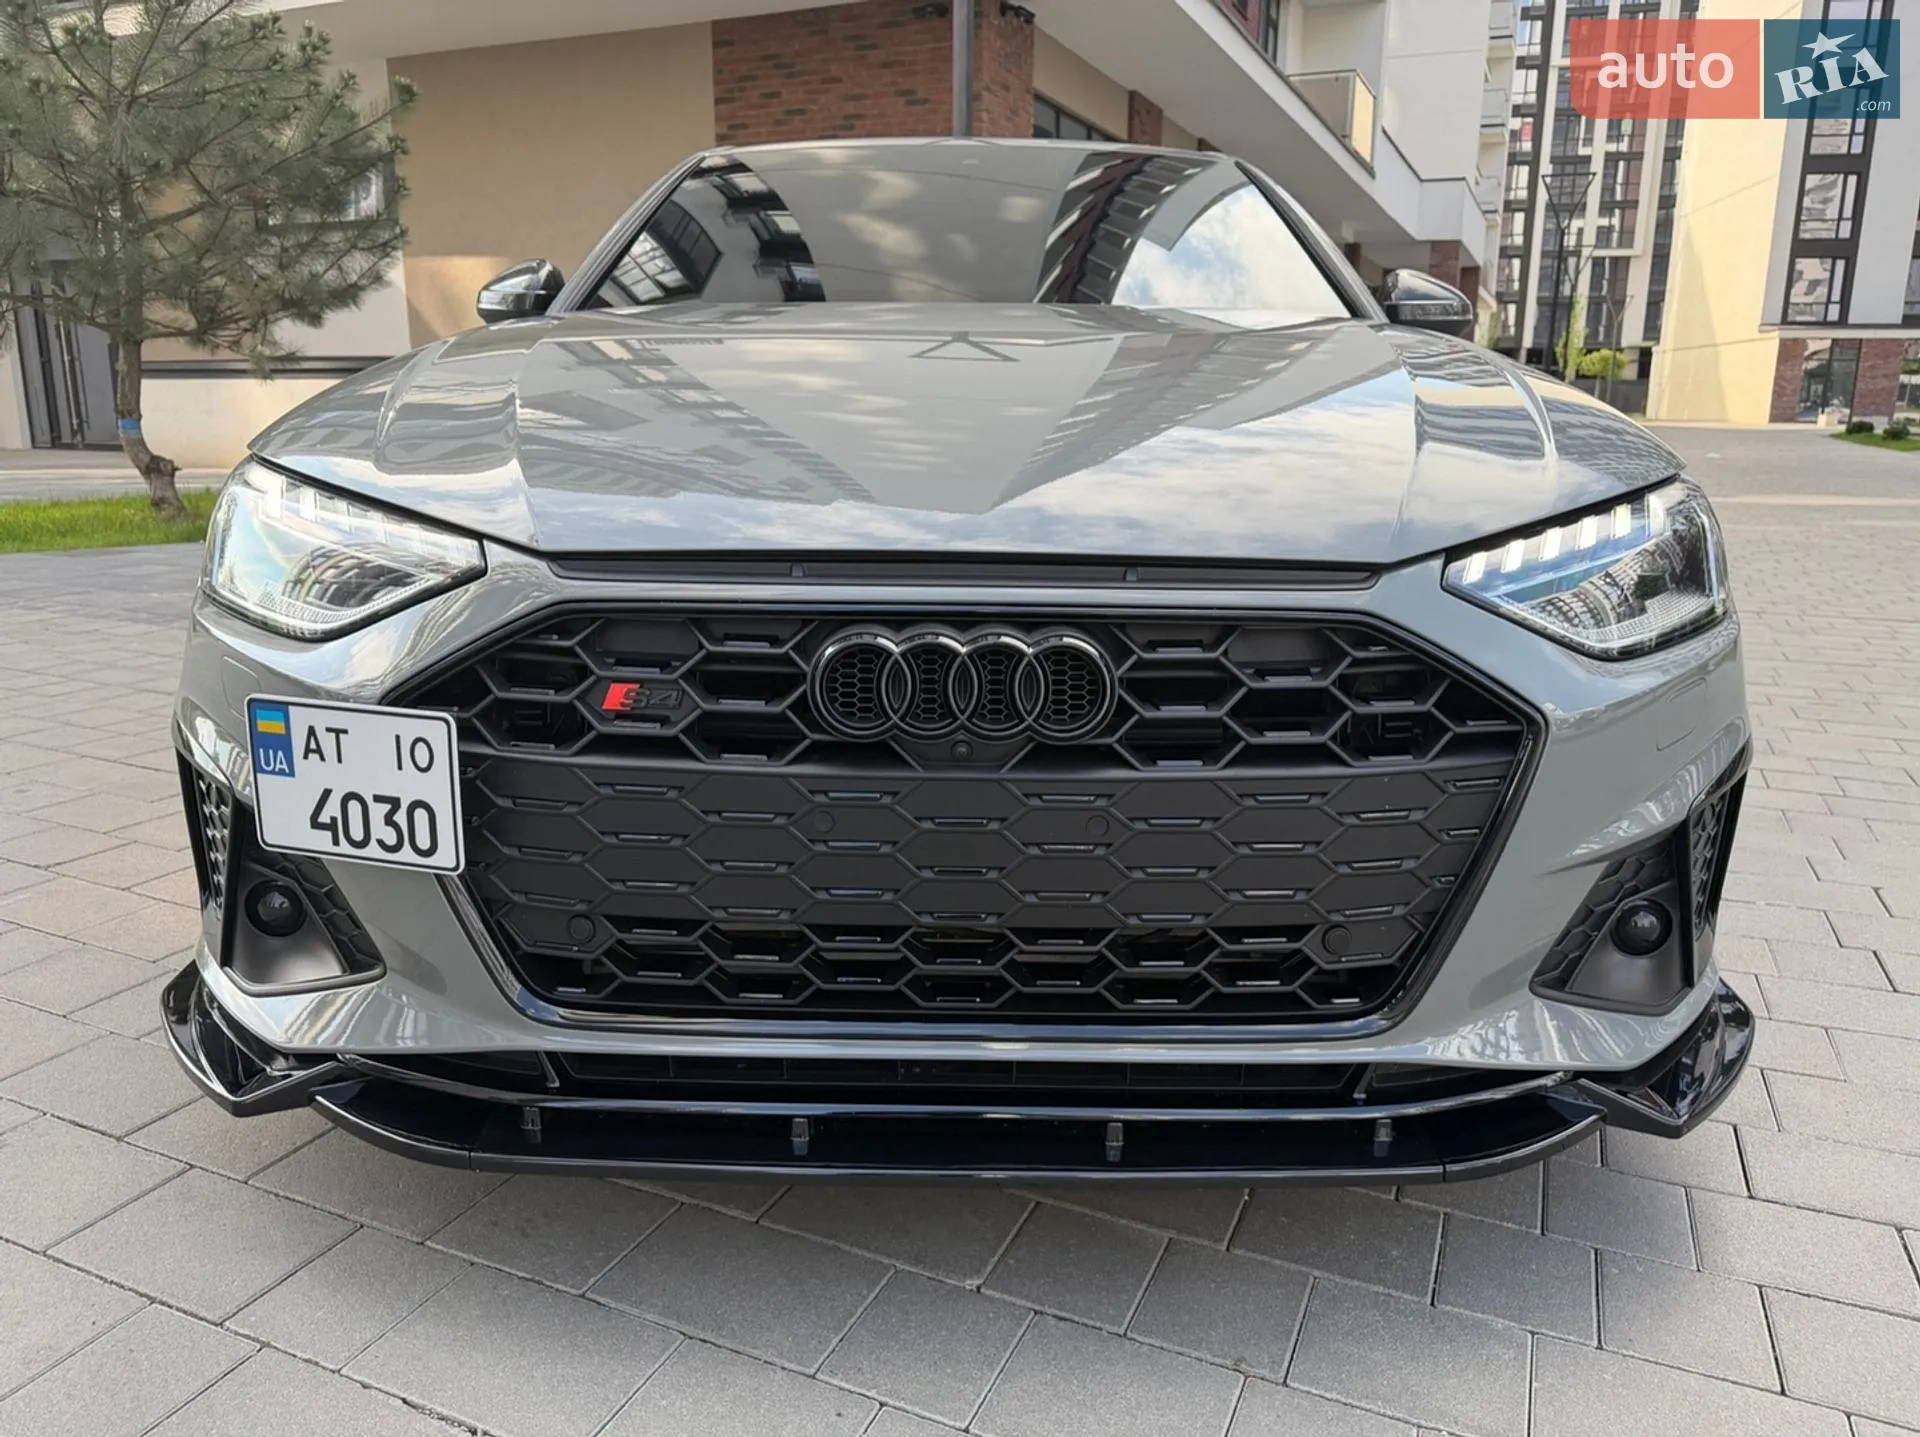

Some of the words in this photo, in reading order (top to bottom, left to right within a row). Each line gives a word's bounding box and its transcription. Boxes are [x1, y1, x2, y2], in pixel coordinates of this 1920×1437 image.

[259, 748, 289, 773] UA
[302, 725, 349, 764] AT
[309, 788, 439, 859] 4030
